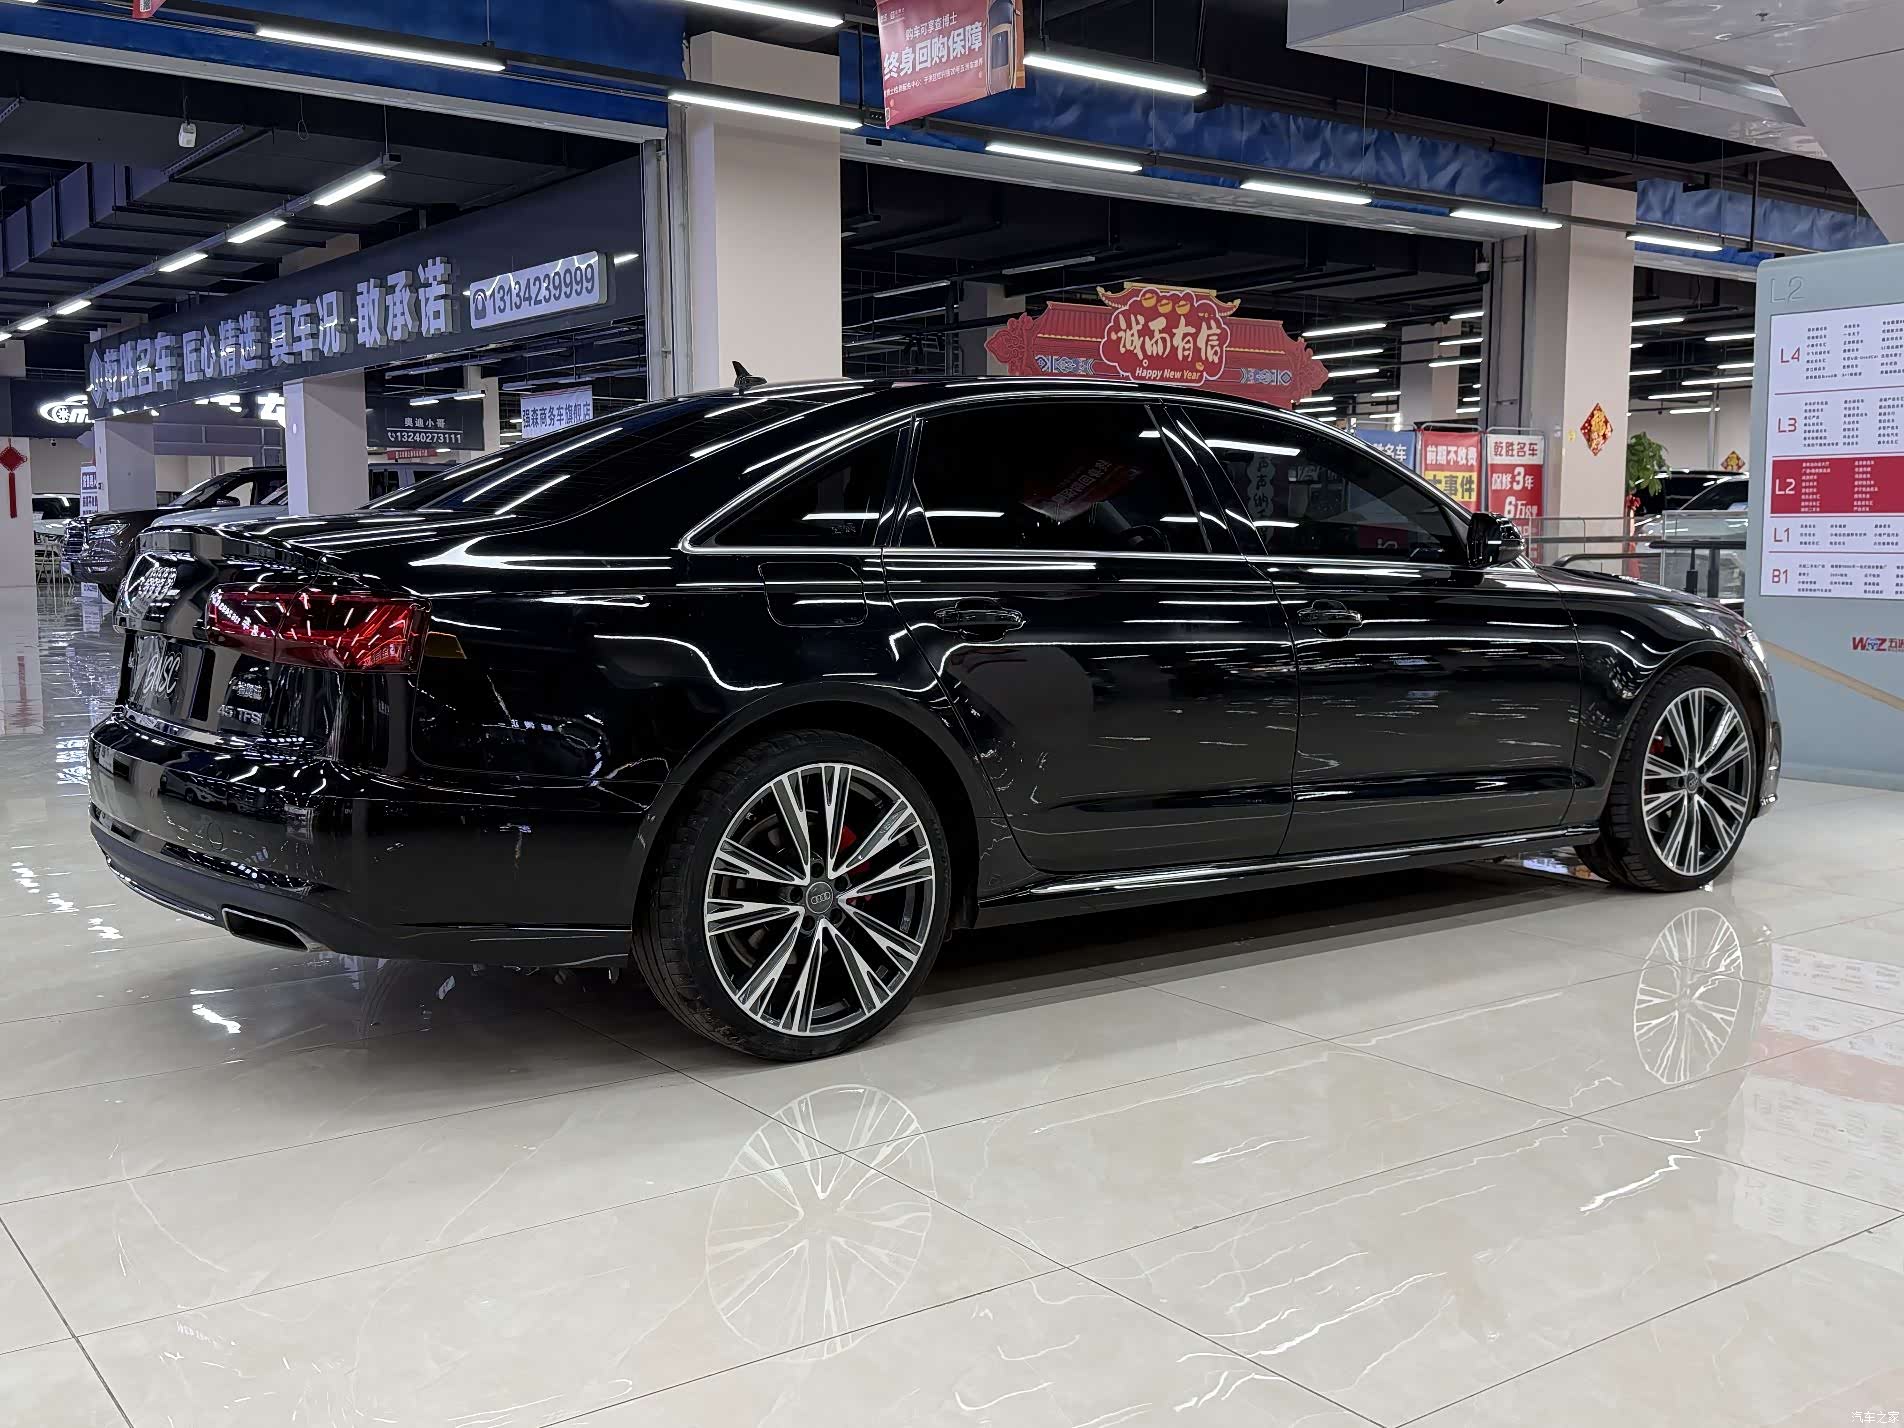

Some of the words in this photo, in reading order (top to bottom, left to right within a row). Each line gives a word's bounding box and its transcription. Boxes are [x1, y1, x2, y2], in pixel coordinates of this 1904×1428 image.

[905, 11, 958, 41] 购车可享查博士
[883, 21, 983, 81] 终身回购保障
[1770, 275, 1807, 303] L2
[269, 290, 346, 367] 真车况
[356, 256, 453, 348] 敢承诺
[489, 263, 595, 315] 13134239999
[1117, 313, 1222, 364] 诚而有信
[1780, 347, 1801, 364] L4
[1135, 367, 1163, 380] Happy
[1163, 369, 1182, 379] New
[1183, 369, 1201, 380] Year
[404, 417, 446, 428] 奥迪小哥
[522, 401, 591, 429] 强森商务车旗舰店
[1777, 417, 1798, 433] L3
[396, 431, 462, 444] 13240273111
[1426, 445, 1477, 466] 前期不收费
[1493, 441, 1538, 457] 乾胜名车
[1491, 466, 1535, 491] 保修3年
[1775, 479, 1796, 495] L2
[1773, 527, 1791, 543] L1
[1771, 568, 1789, 585] B1
